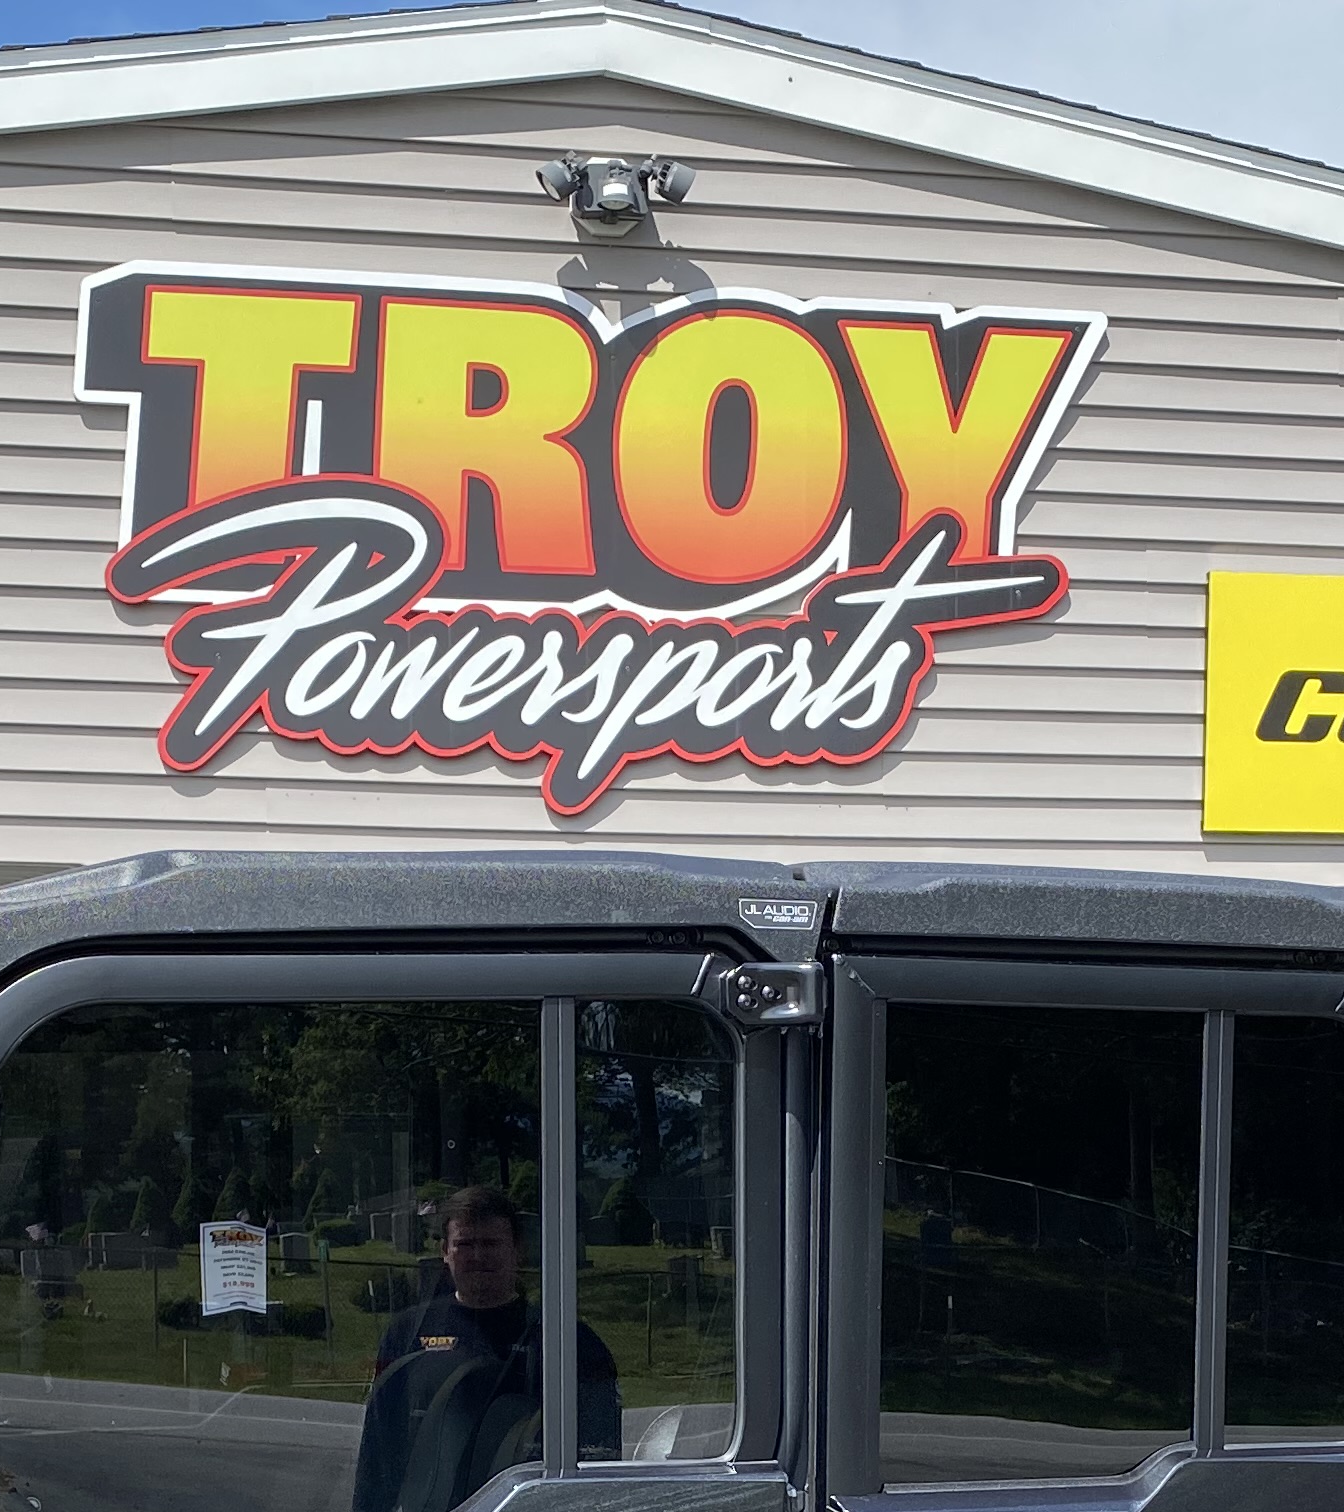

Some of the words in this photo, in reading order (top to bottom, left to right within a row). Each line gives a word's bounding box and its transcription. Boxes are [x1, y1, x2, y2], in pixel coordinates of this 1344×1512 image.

[134, 280, 1078, 588] TROY
[136, 490, 1050, 784] Powersports
[744, 904, 762, 915] JL
